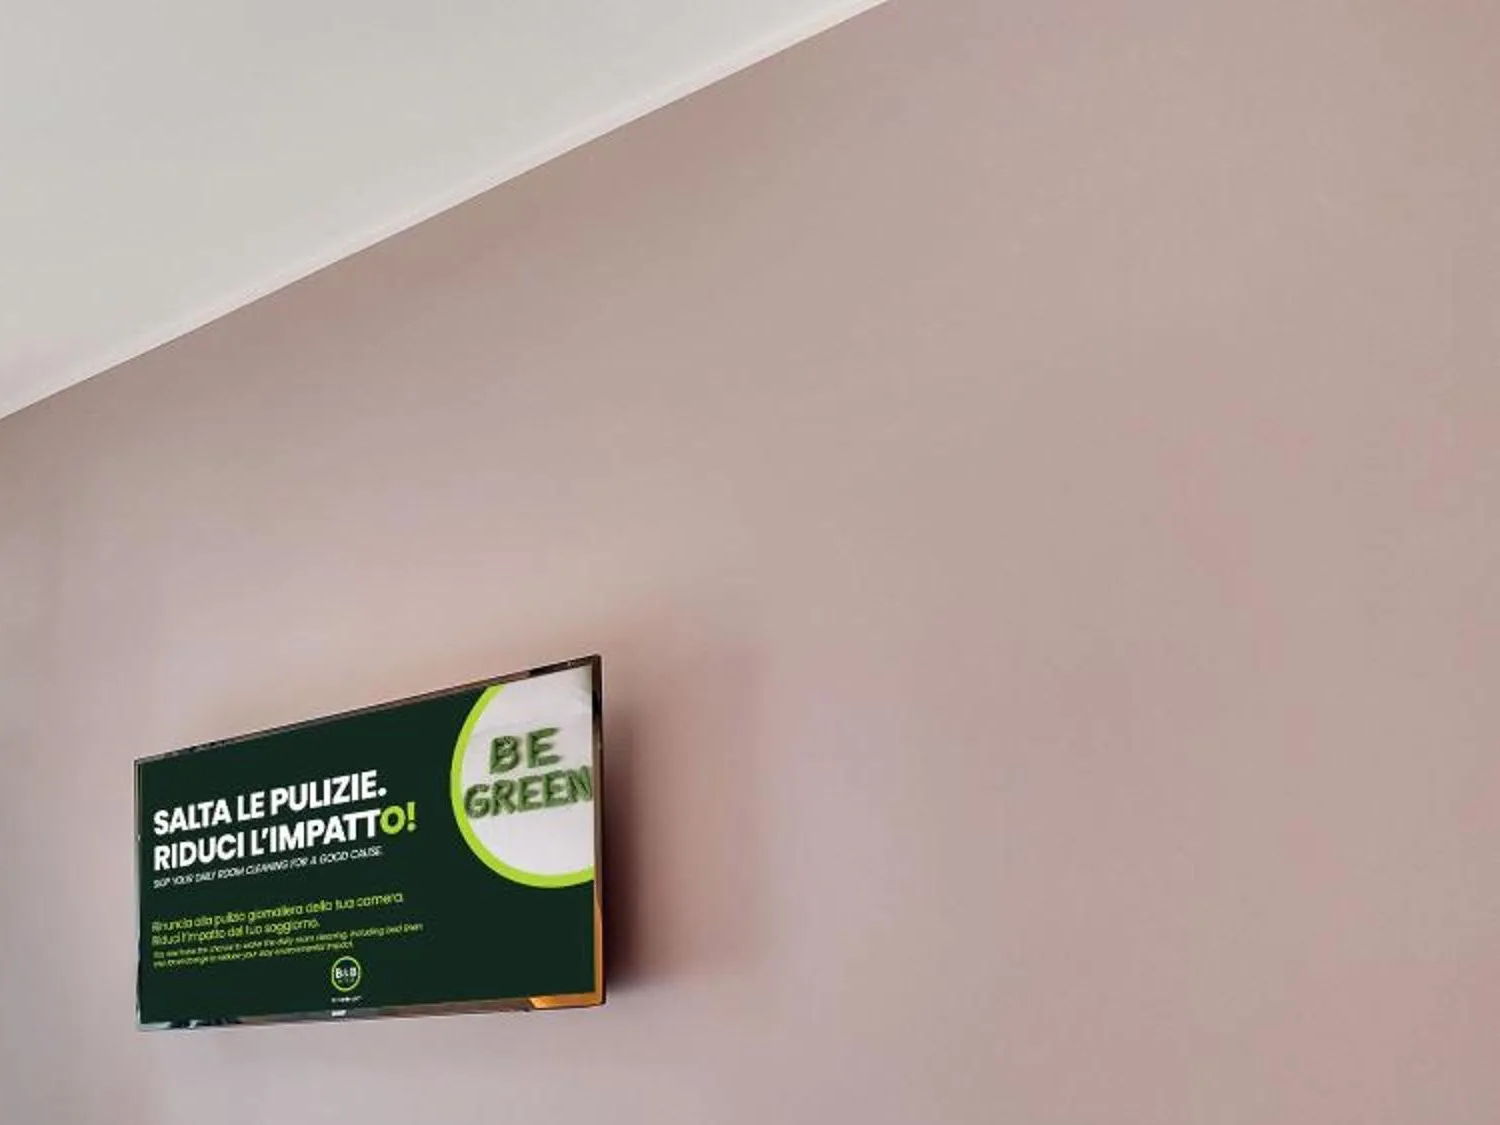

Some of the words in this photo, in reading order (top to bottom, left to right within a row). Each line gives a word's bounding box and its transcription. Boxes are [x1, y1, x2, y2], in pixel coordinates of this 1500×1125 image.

[488, 727, 563, 774] BE
[154, 798, 232, 836] SALTA
[237, 791, 265, 821] LE
[270, 769, 388, 816] PULIZIE.
[464, 765, 592, 819] GREEN
[154, 832, 244, 871] RIDUCI
[251, 801, 416, 857] L'IMPATTO!
[172, 874, 195, 886] YOUR
[195, 871, 217, 883] DAILY
[217, 866, 245, 879] ROOM
[246, 859, 289, 875] CLEANING
[290, 856, 308, 869] FOR
[310, 855, 317, 865] A
[319, 850, 349, 865] GOOD
[305, 900, 333, 913] della
[335, 898, 355, 911] tua
[245, 924, 263, 935] tuo
